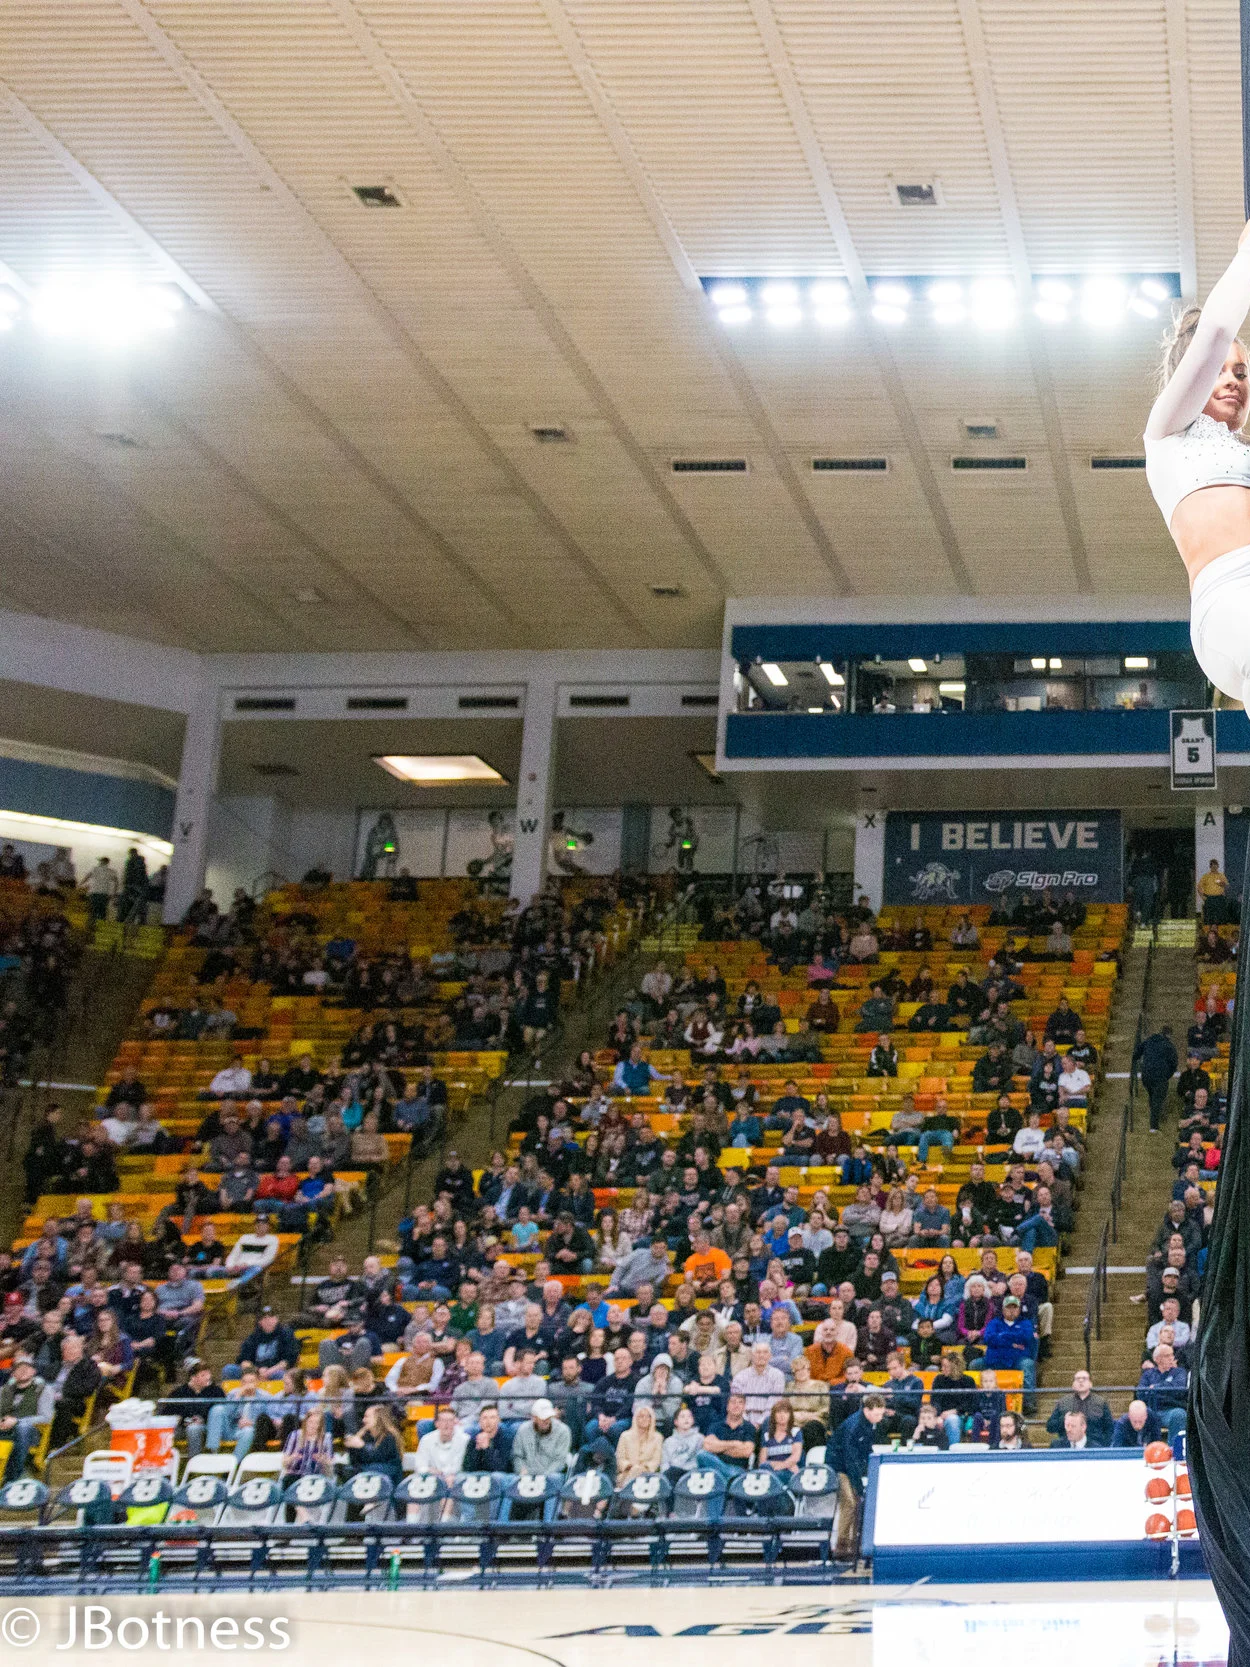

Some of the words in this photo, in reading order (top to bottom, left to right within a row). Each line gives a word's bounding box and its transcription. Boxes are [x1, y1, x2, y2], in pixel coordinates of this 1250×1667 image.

[1188, 747, 1200, 763] 5
[520, 818, 538, 833] W
[865, 814, 875, 828] X
[1203, 811, 1215, 826] A
[911, 823, 920, 850] I
[941, 822, 1099, 850] BELIEVE
[1016, 871, 1061, 889] Sign
[1061, 871, 1098, 886] Pro
